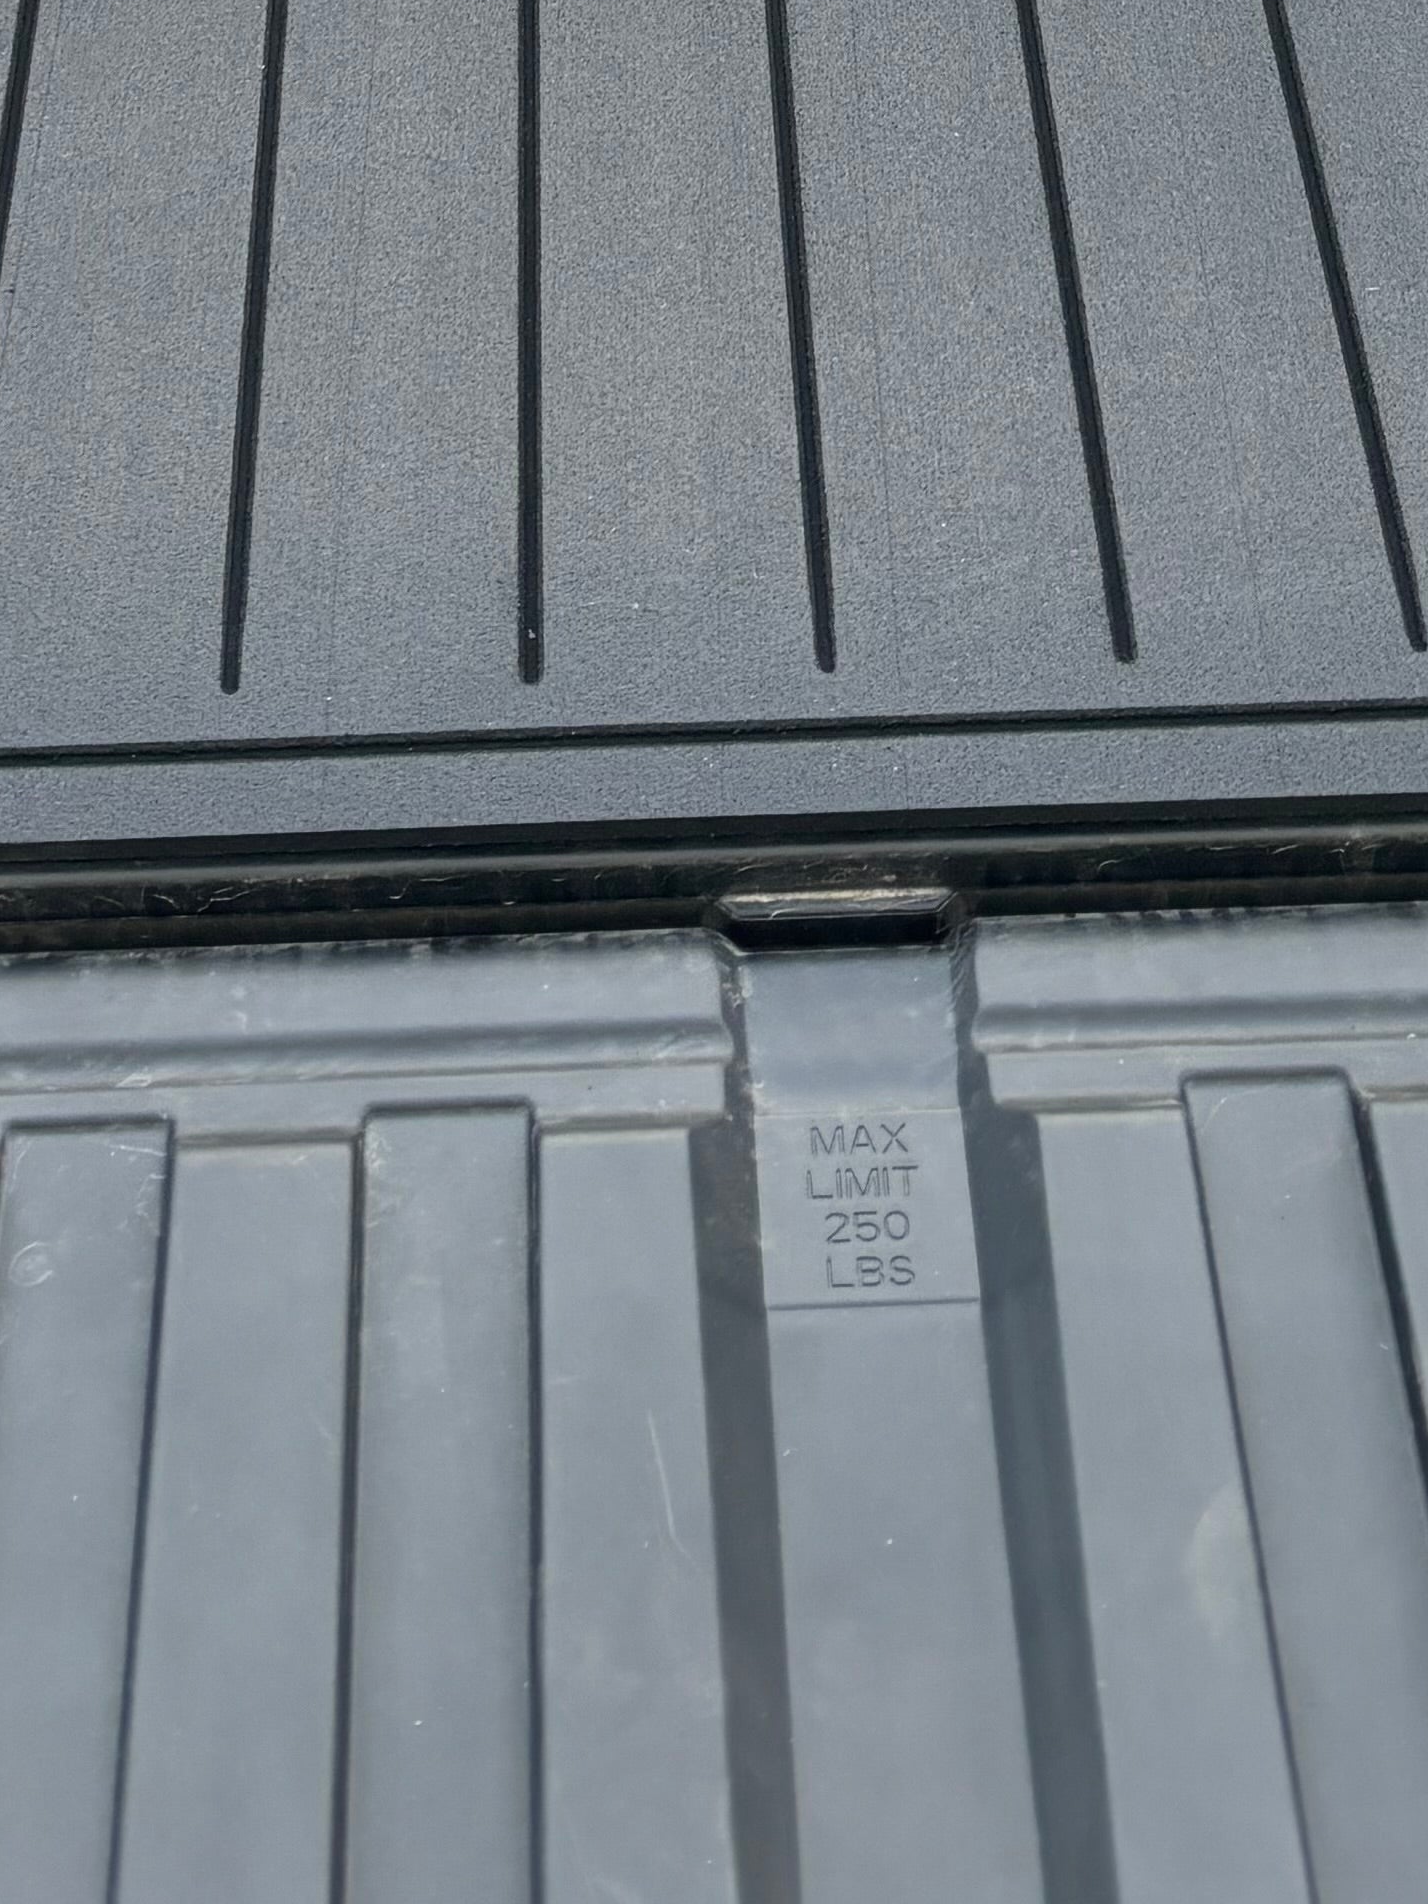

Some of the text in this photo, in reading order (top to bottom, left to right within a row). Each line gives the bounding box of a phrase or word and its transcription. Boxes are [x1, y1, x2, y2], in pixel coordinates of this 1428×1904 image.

[810, 1122, 909, 1156] MAX
[805, 1165, 919, 1199] LIMIT
[824, 1210, 910, 1243] 250
[826, 1255, 915, 1288] LBS
